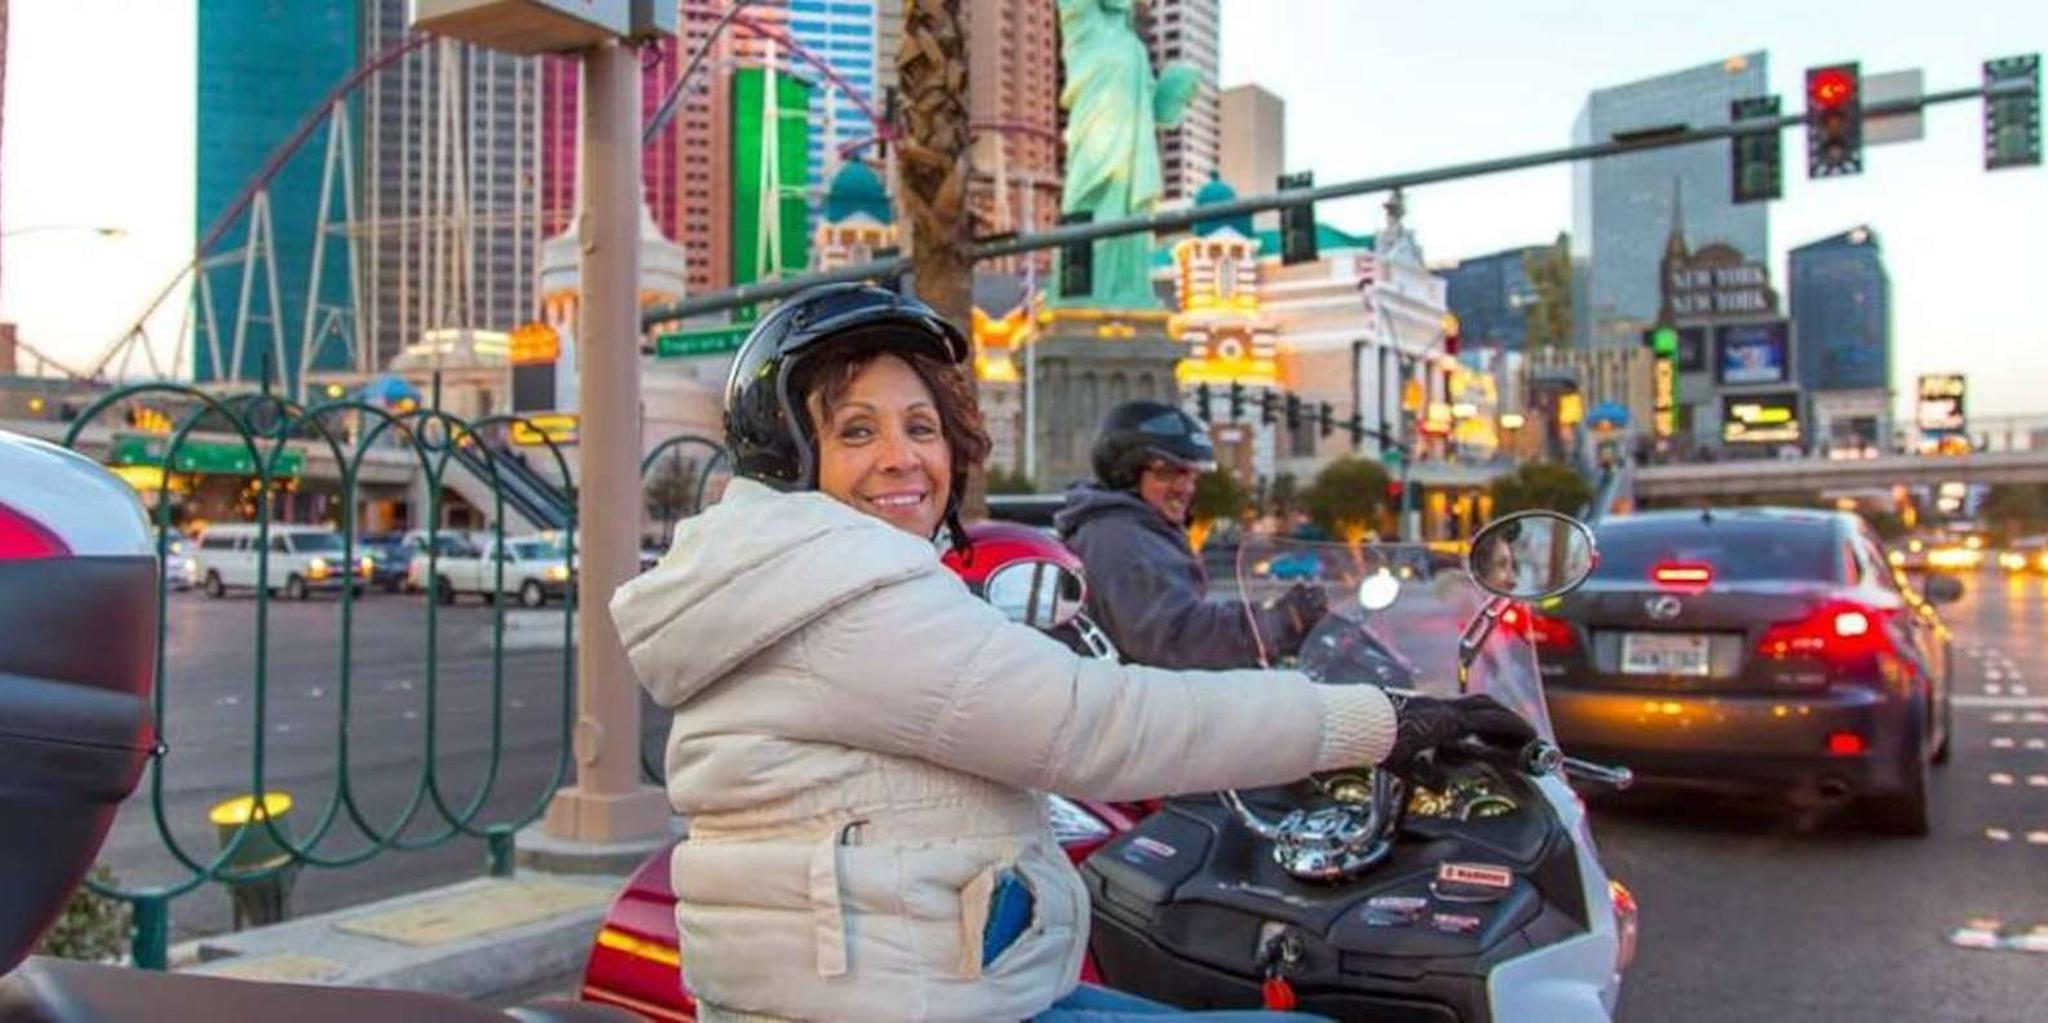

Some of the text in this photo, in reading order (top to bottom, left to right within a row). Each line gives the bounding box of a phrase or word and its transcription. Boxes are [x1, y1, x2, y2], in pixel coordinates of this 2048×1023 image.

[1674, 267, 1763, 287] NEW YORK
[1674, 291, 1765, 312] NEW YORK
